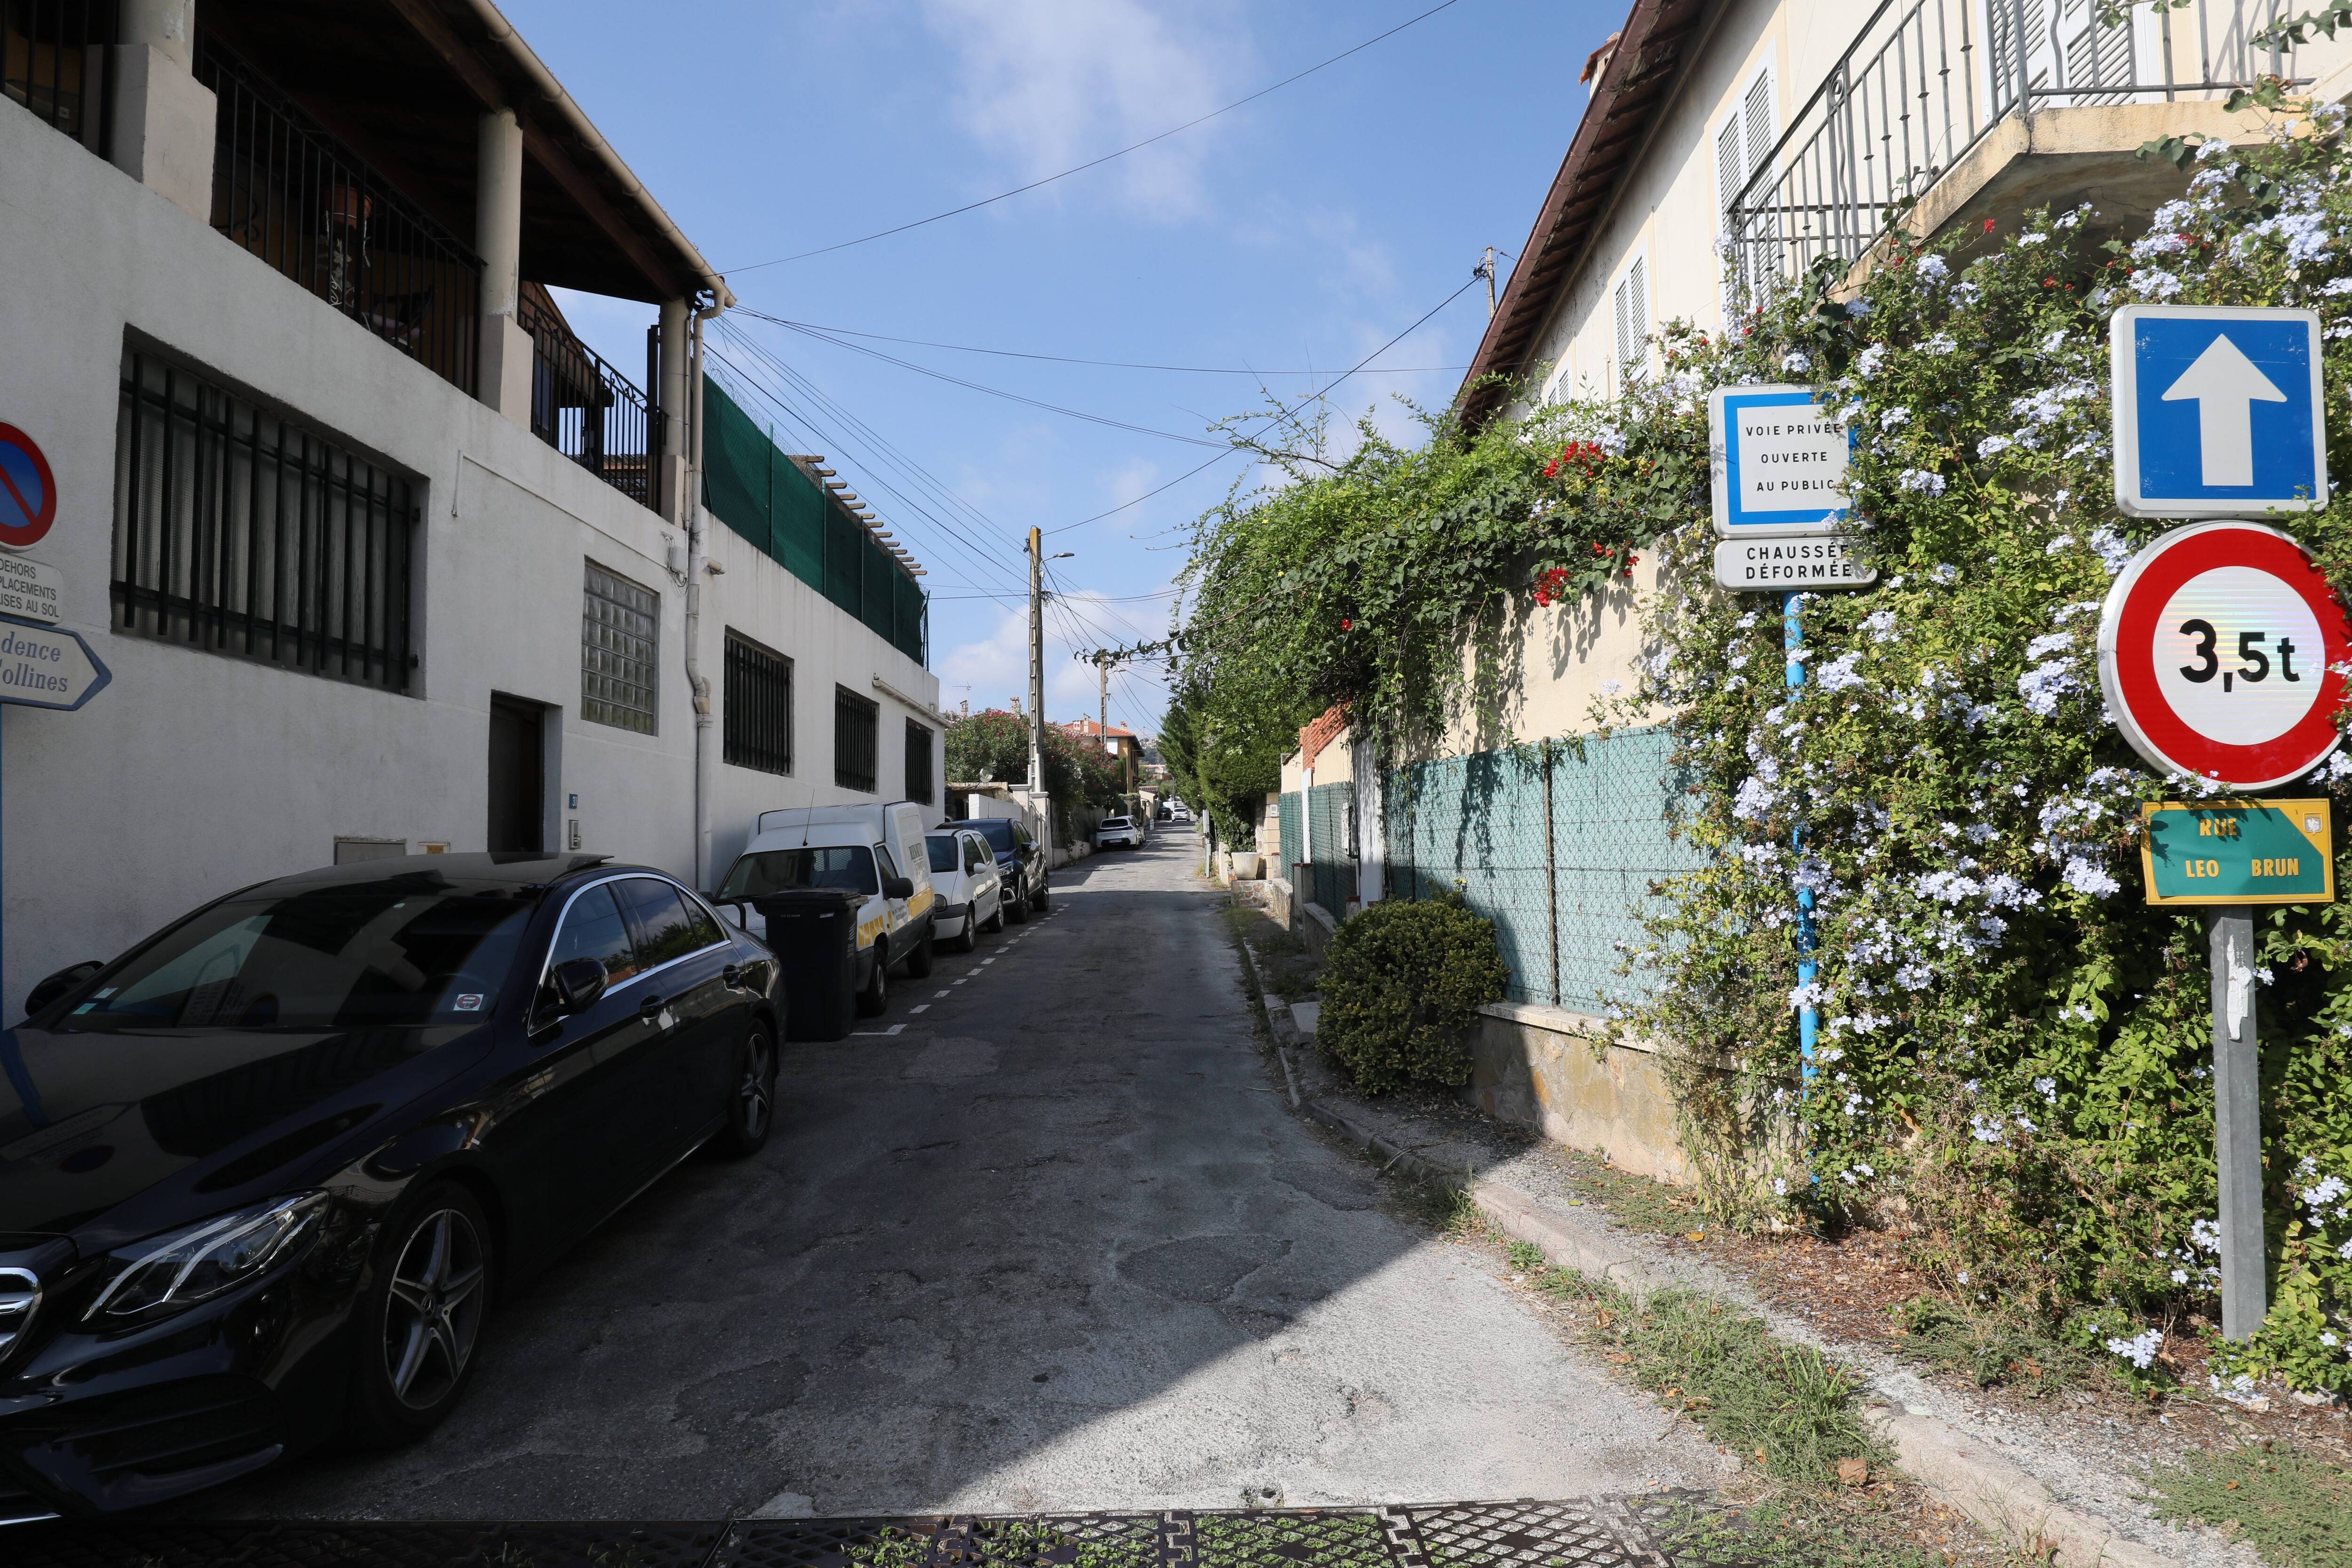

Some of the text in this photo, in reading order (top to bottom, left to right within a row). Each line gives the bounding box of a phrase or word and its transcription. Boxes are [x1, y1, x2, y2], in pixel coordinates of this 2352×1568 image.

[1746, 422, 1841, 436] VOIE PRIVÉE
[1761, 452, 1828, 463] OUVERTE
[1756, 479, 1835, 492] AU PUBLIC
[1746, 561, 1851, 579] DÉFORMÉE
[0, 593, 59, 618] ISES AU SOL
[2179, 619, 2300, 692] 3,5t
[0, 659, 68, 692] ollines
[572, 796, 577, 806] 31
[2200, 818, 2238, 836] RUE
[2185, 858, 2299, 877] LEO BRUN
